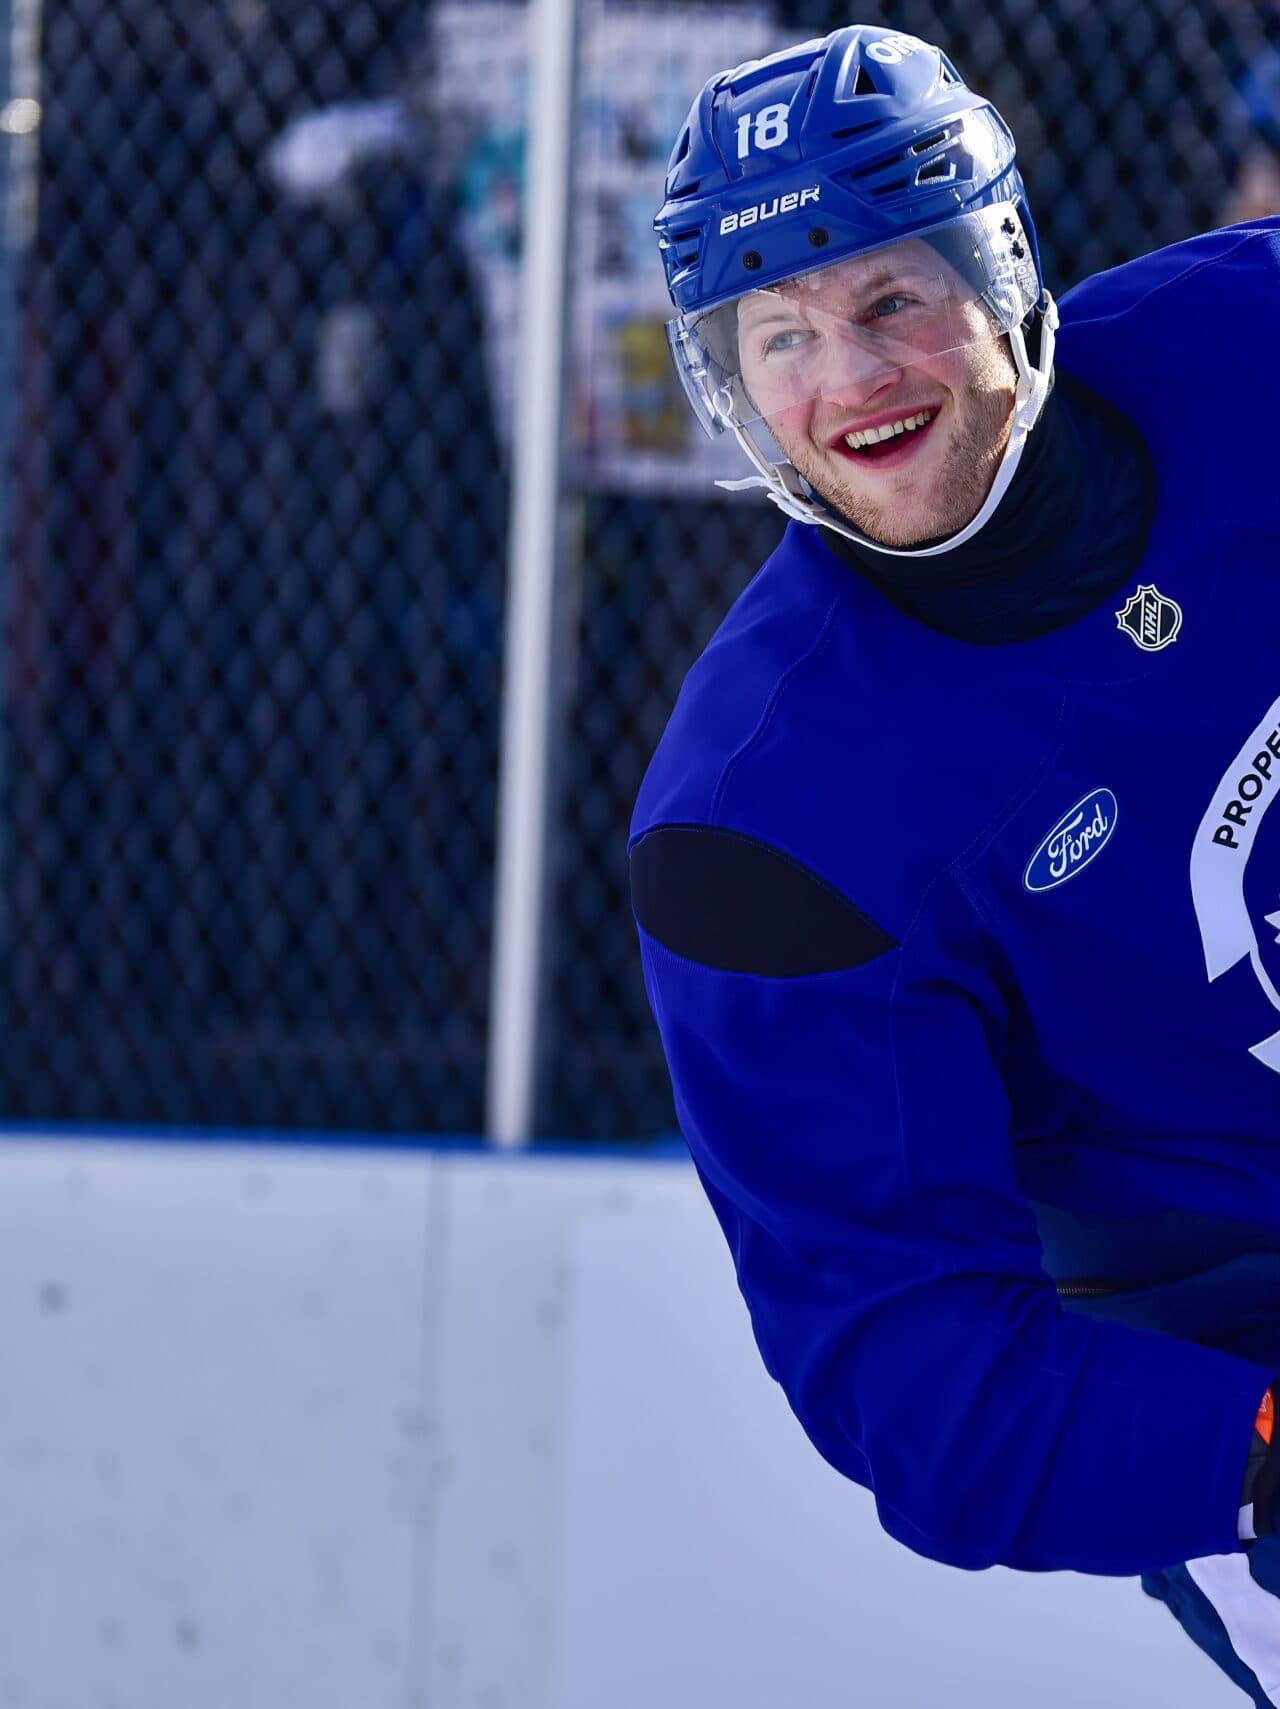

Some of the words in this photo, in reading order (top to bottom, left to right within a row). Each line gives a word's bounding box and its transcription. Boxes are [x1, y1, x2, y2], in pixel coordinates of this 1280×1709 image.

[736, 102, 790, 159] 18
[719, 184, 820, 236] BAUER
[1144, 601, 1157, 642] NHL
[1047, 802, 1108, 878] Ford
